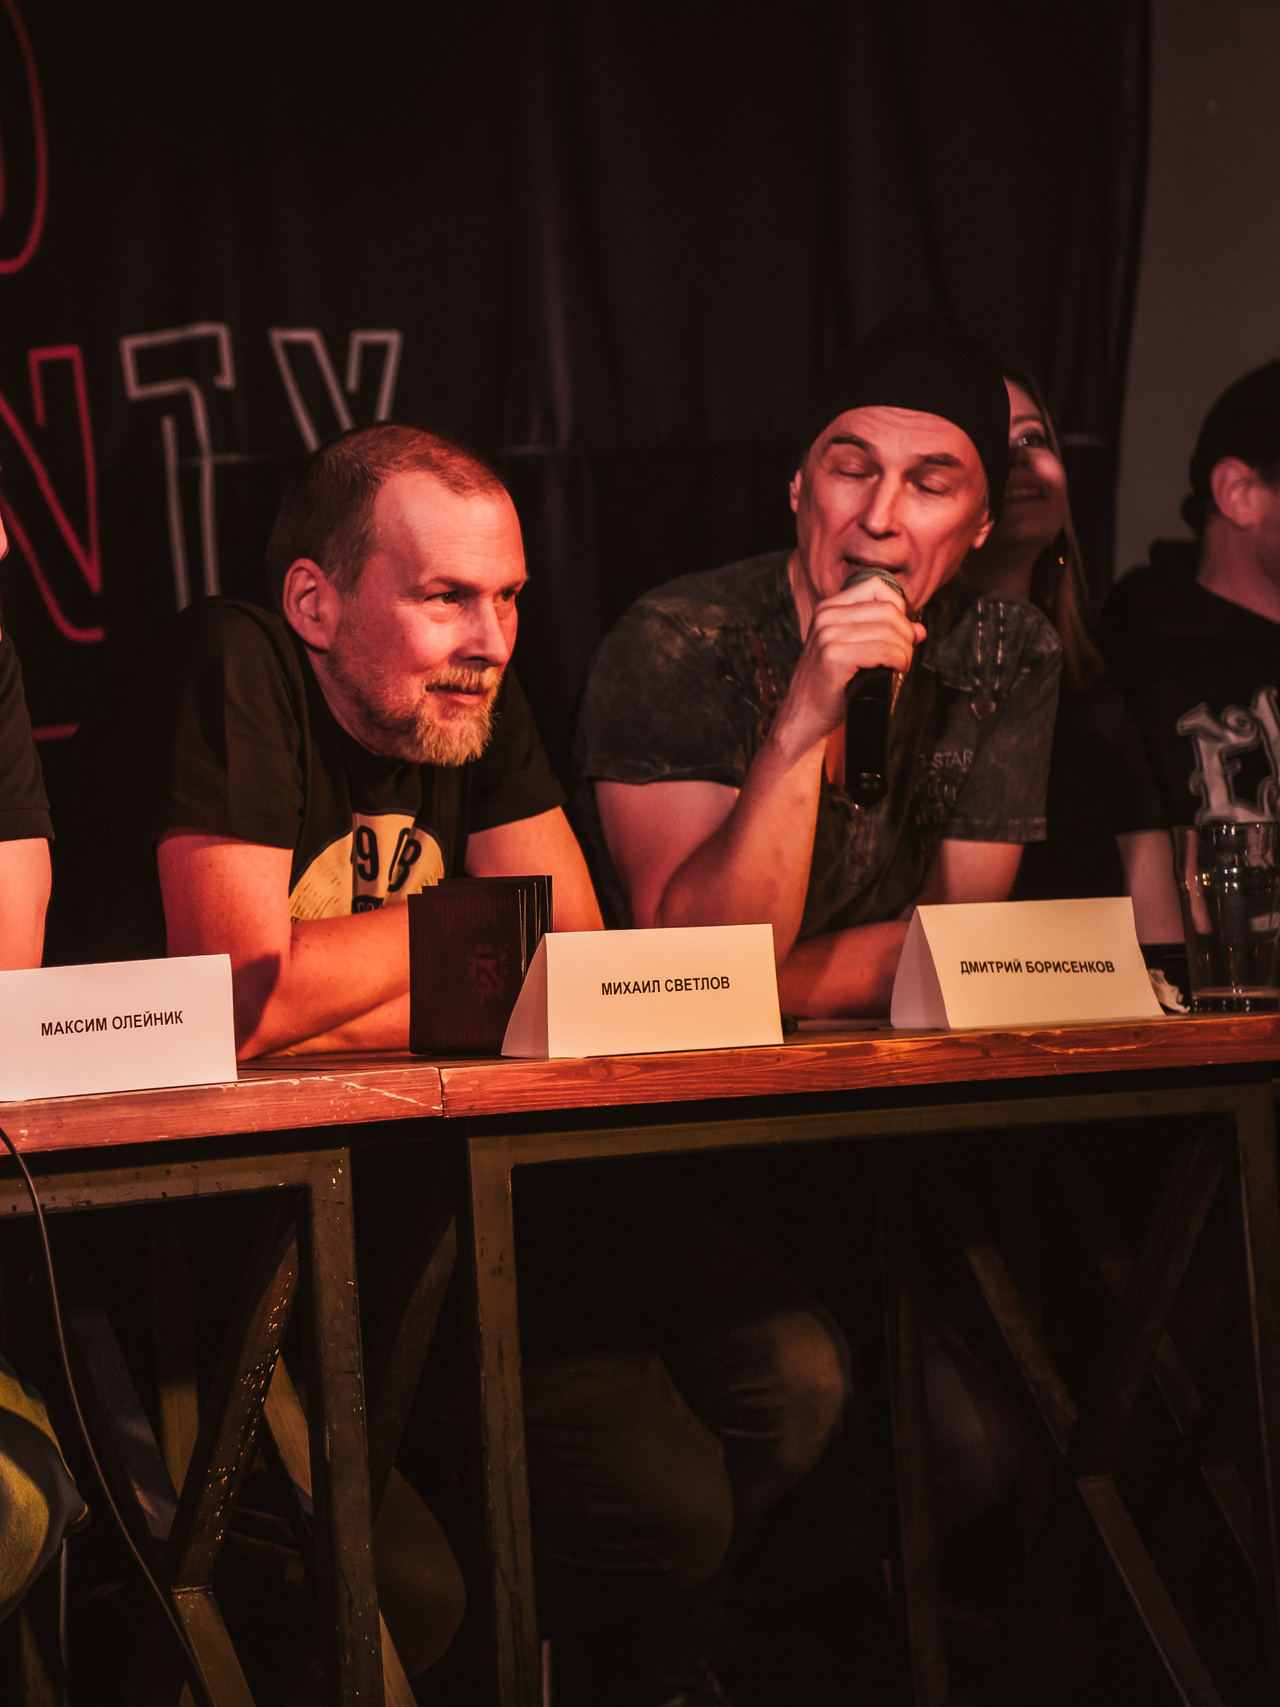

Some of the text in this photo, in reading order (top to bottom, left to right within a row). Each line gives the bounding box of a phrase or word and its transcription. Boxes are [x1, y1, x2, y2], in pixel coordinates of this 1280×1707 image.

[960, 958, 1115, 975] ДМИТРИЙ БОРИСЕНКОВ
[601, 975, 731, 996] МИХАИЛ СВЕТЛОВ
[40, 1010, 184, 1037] МАКСИМ ОЛЕЙНИК
